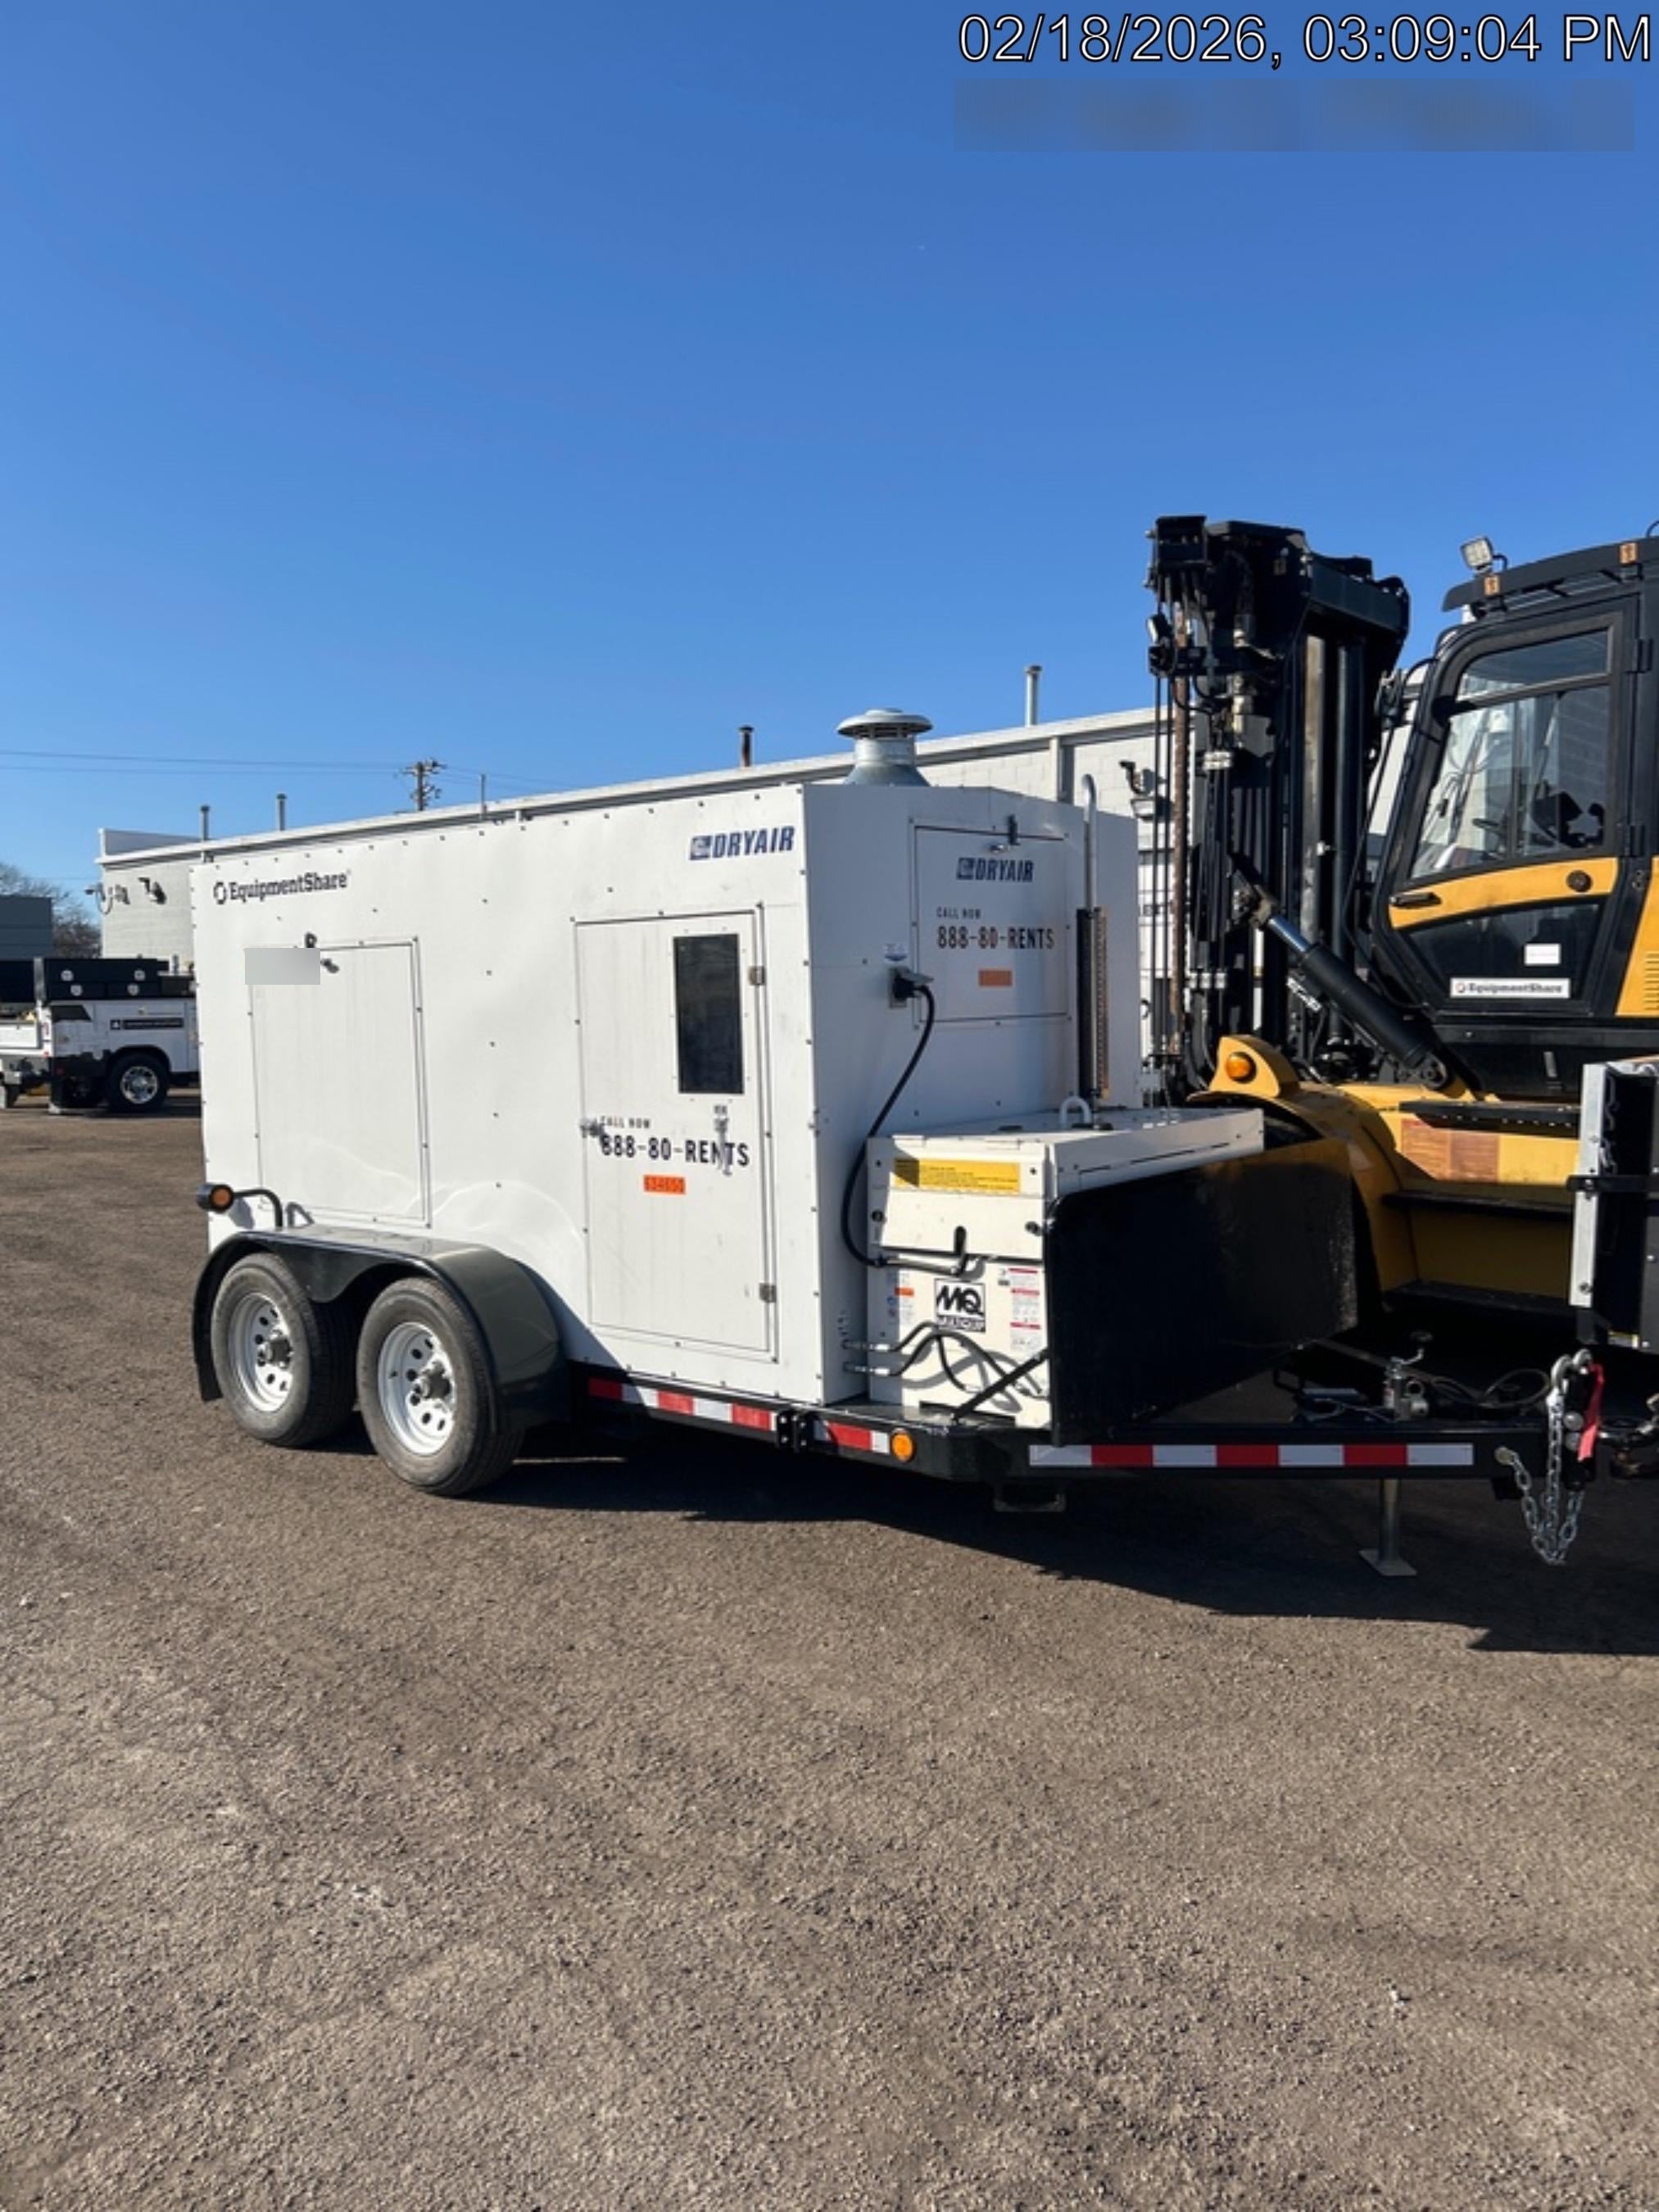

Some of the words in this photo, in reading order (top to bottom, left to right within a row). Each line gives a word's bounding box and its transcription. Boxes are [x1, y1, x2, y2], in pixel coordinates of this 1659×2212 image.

[713, 826, 795, 858] DRYAIR
[975, 859, 1034, 882] DRYAIR
[229, 873, 347, 902] EquipmentShare
[937, 926, 1055, 950] 888-80-RENTS
[601, 1134, 750, 1167] 888-80-RENTS
[936, 1285, 984, 1317] MQ
